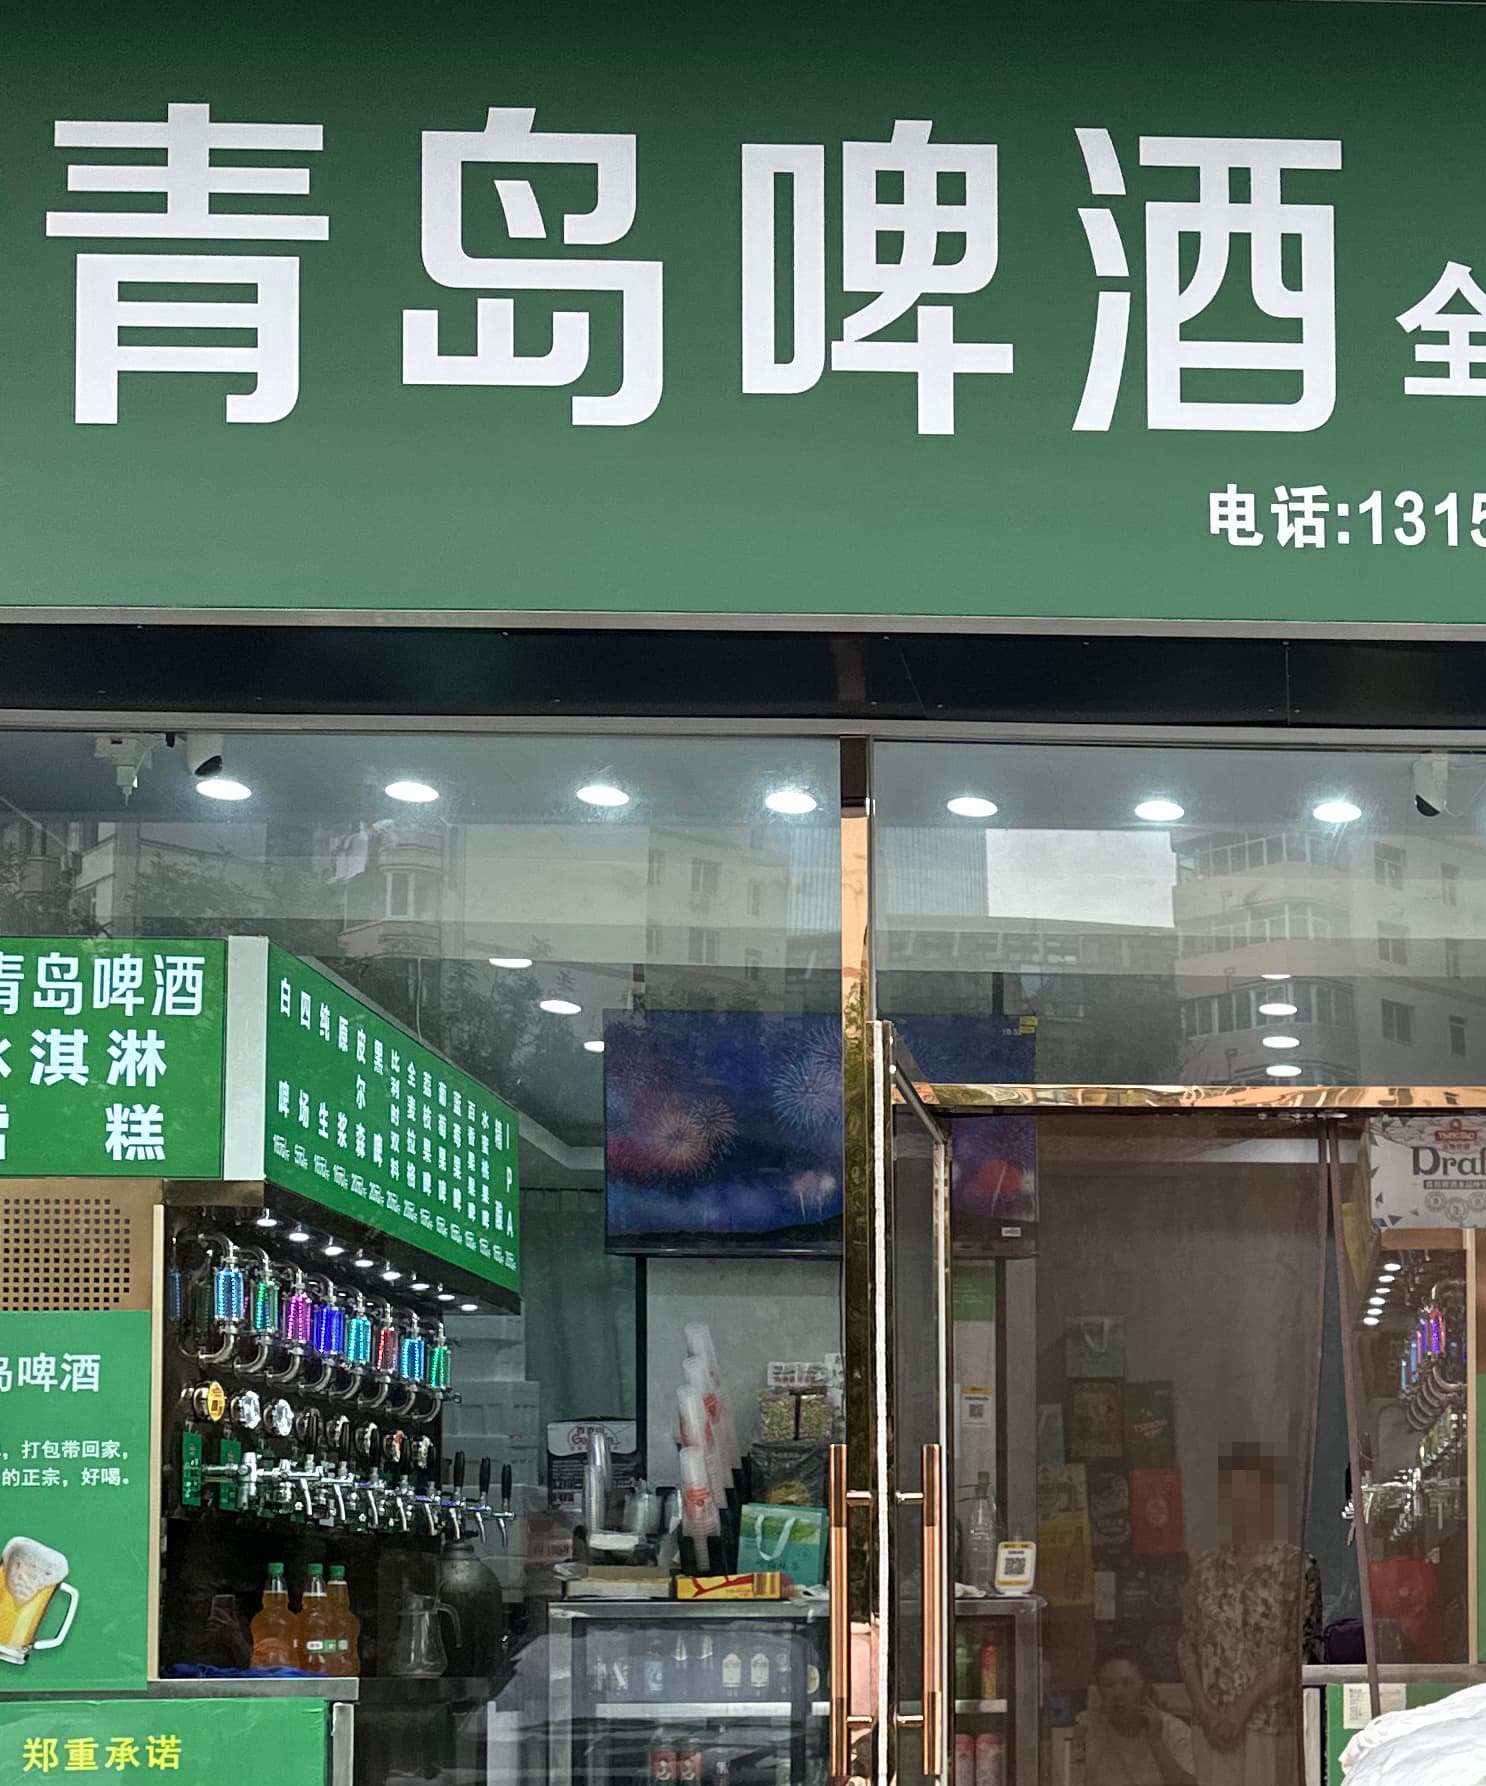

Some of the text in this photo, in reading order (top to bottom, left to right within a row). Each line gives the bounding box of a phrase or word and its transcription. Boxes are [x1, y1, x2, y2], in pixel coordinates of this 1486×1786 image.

[45, 102, 1343, 435] 青岛啤酒
[22, 1735, 183, 1773] 郑重承诺
